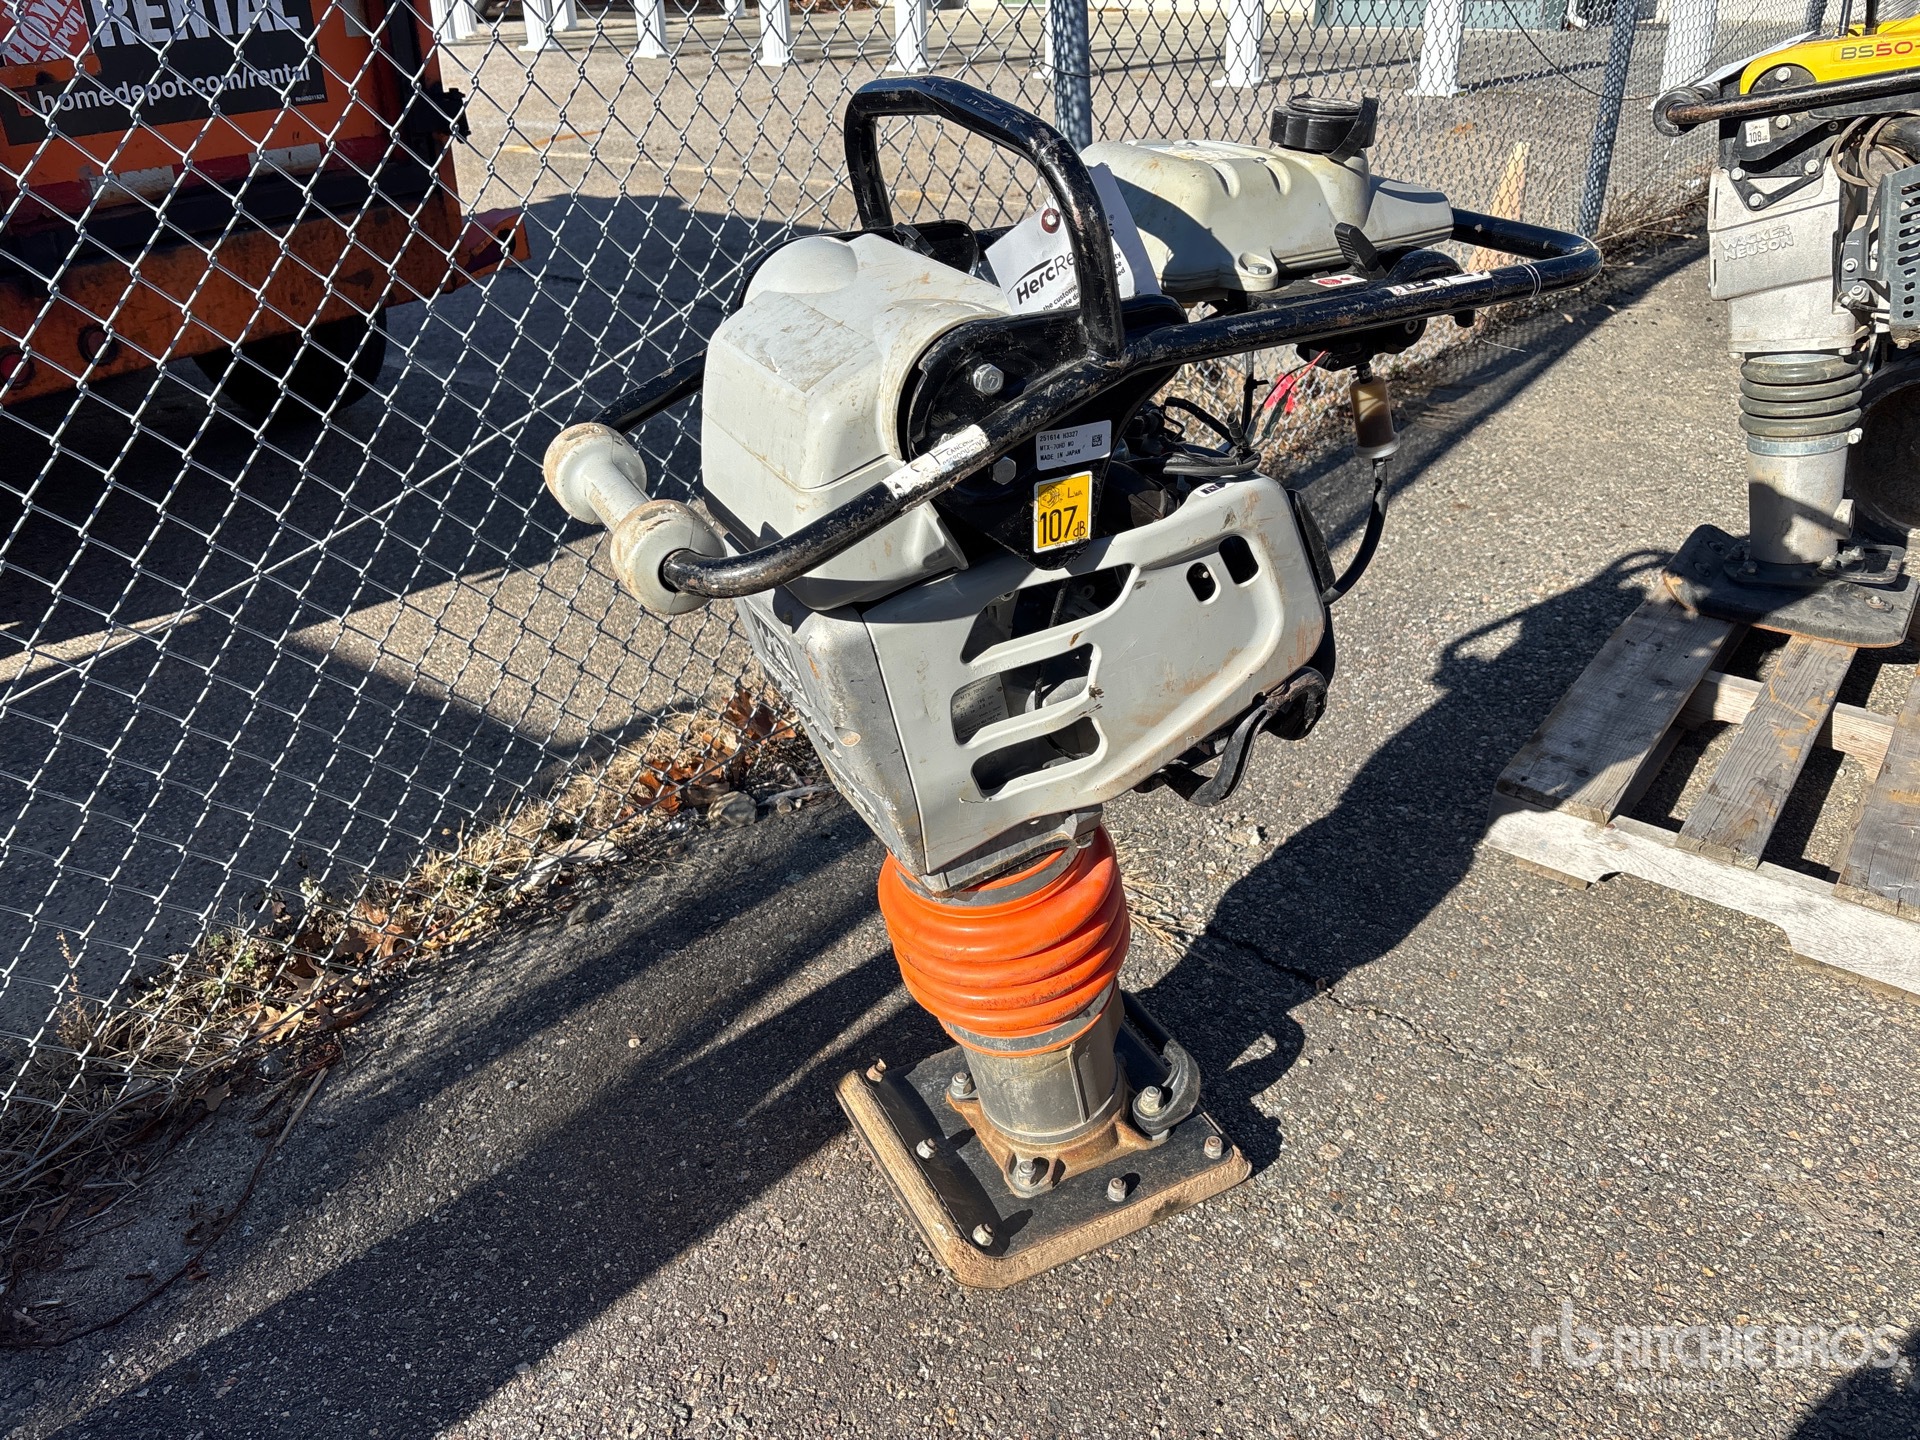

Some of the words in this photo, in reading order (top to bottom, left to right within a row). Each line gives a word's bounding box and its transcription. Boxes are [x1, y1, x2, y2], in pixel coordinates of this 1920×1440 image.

[37, 63, 311, 114] homedepot.com/rental
[1720, 224, 1792, 250] WACKER
[1723, 235, 1794, 262] NEUSON
[1053, 285, 1077, 304] custome
[1039, 434, 1060, 442] 251614
[1063, 431, 1078, 439] H3327
[1066, 448, 1081, 457] JAPAN
[1039, 505, 1078, 545] 107
[1073, 520, 1086, 537] dB
